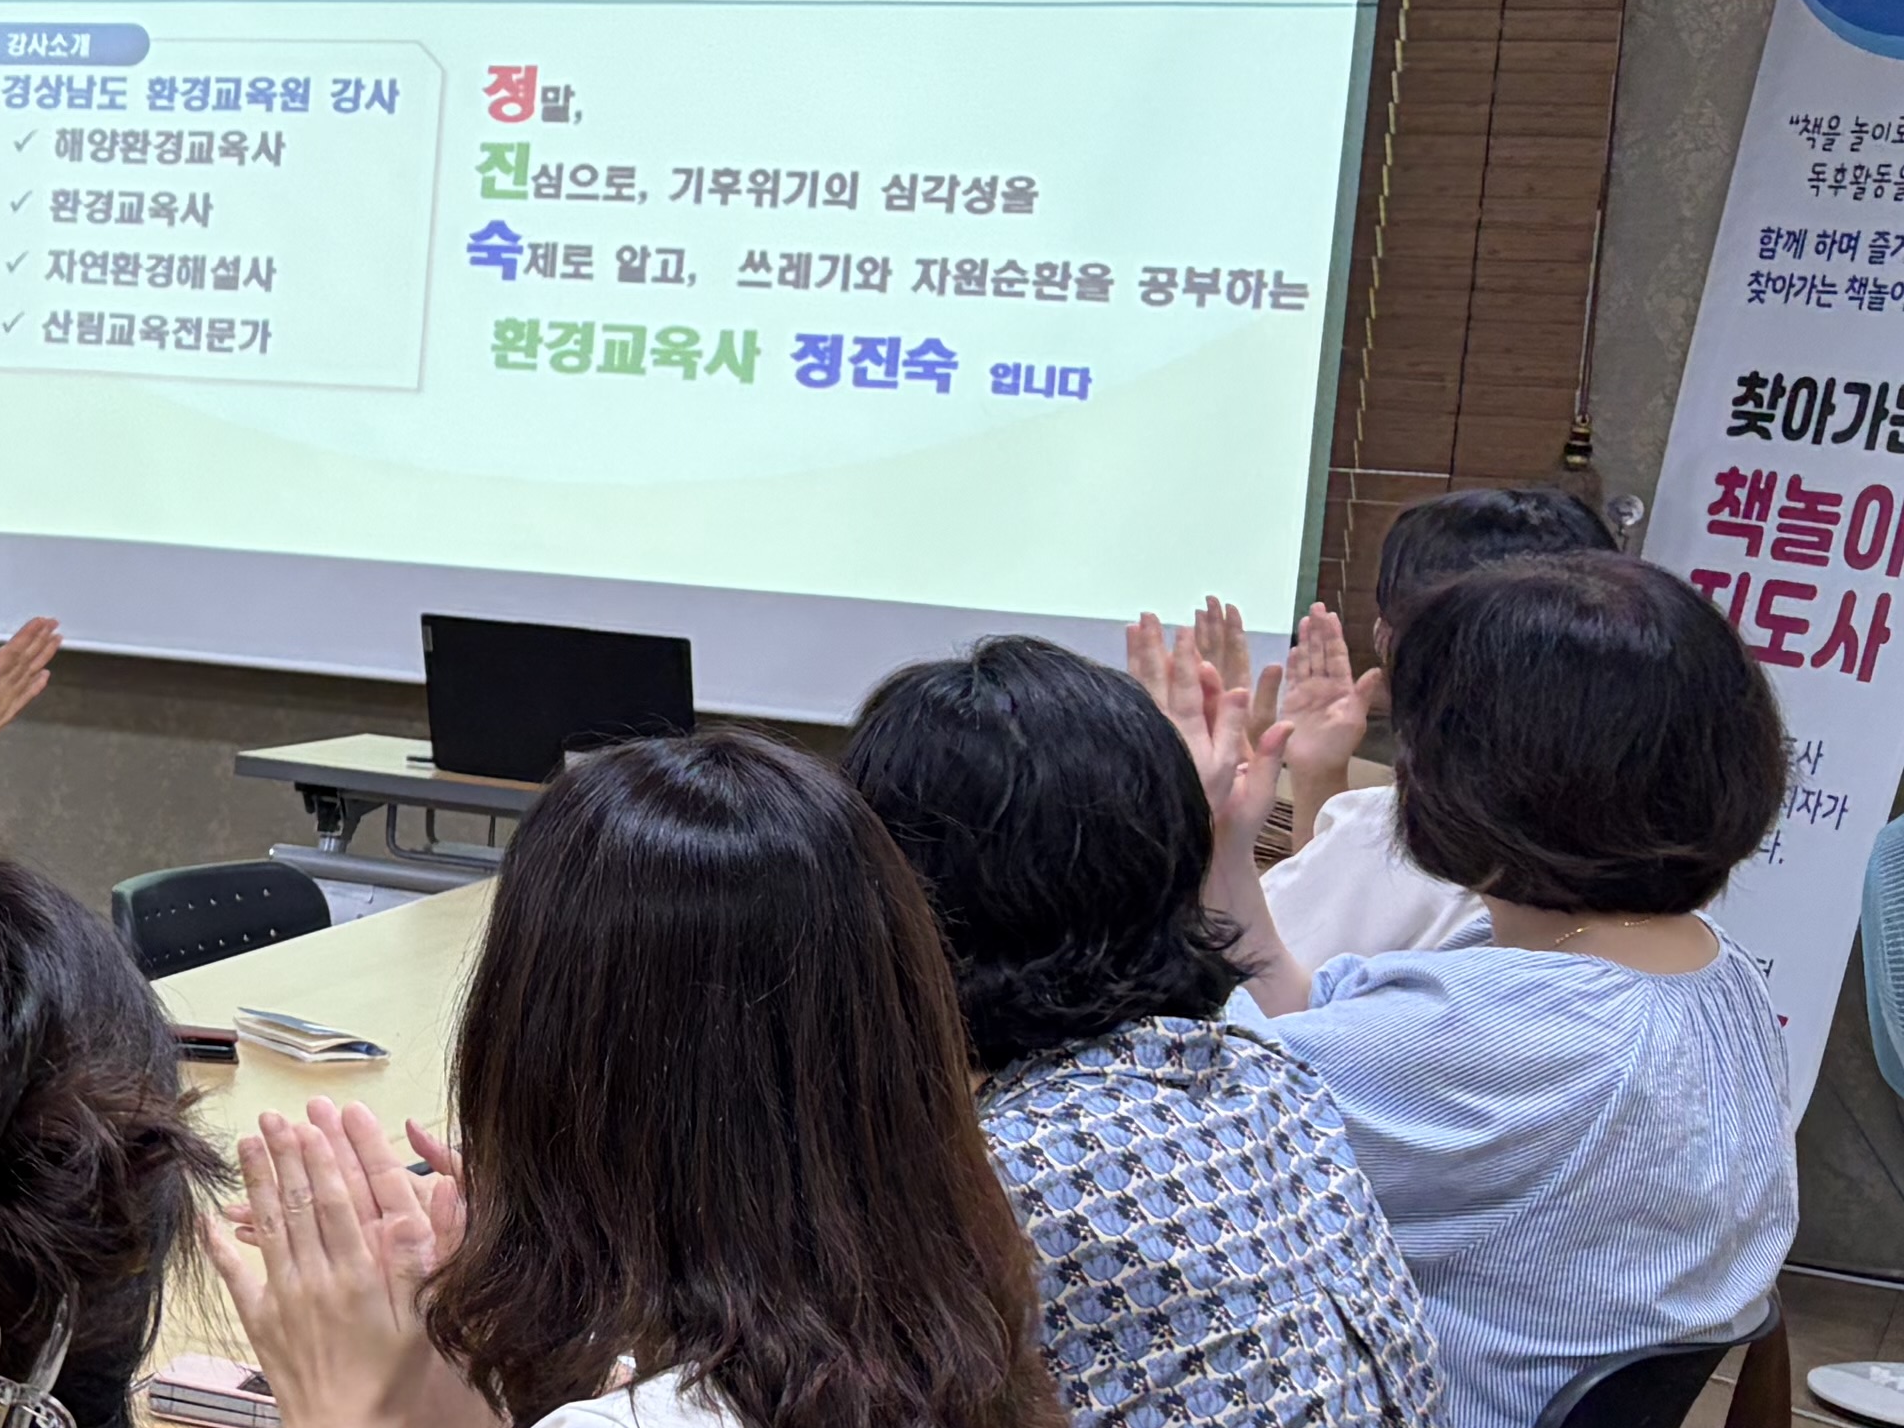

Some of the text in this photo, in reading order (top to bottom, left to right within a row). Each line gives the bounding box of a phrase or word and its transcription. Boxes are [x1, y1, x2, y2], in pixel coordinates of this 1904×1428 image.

[7, 32, 91, 59] 강사소개
[1, 74, 400, 115] 경상남도 환경교육원 강사
[481, 65, 583, 125] 정말,
[53, 127, 287, 167] 해양환경교육사
[474, 141, 1040, 215] 진심으로, 기후위기의 심각성을
[48, 188, 214, 228] 환경교육사
[466, 219, 1311, 311] 숙제로 알고, 쓰레기와 자원순환을 공부하는
[1759, 226, 1808, 260] 함께
[1814, 230, 1861, 262] 하며
[44, 248, 277, 293] 자연환경해설사
[1747, 270, 1838, 308] 찾아가는
[41, 309, 273, 355] 산림교육전문가
[491, 317, 1093, 402] 환경교육사 정진숙 입니다
[1707, 466, 1904, 578] 책놀이
